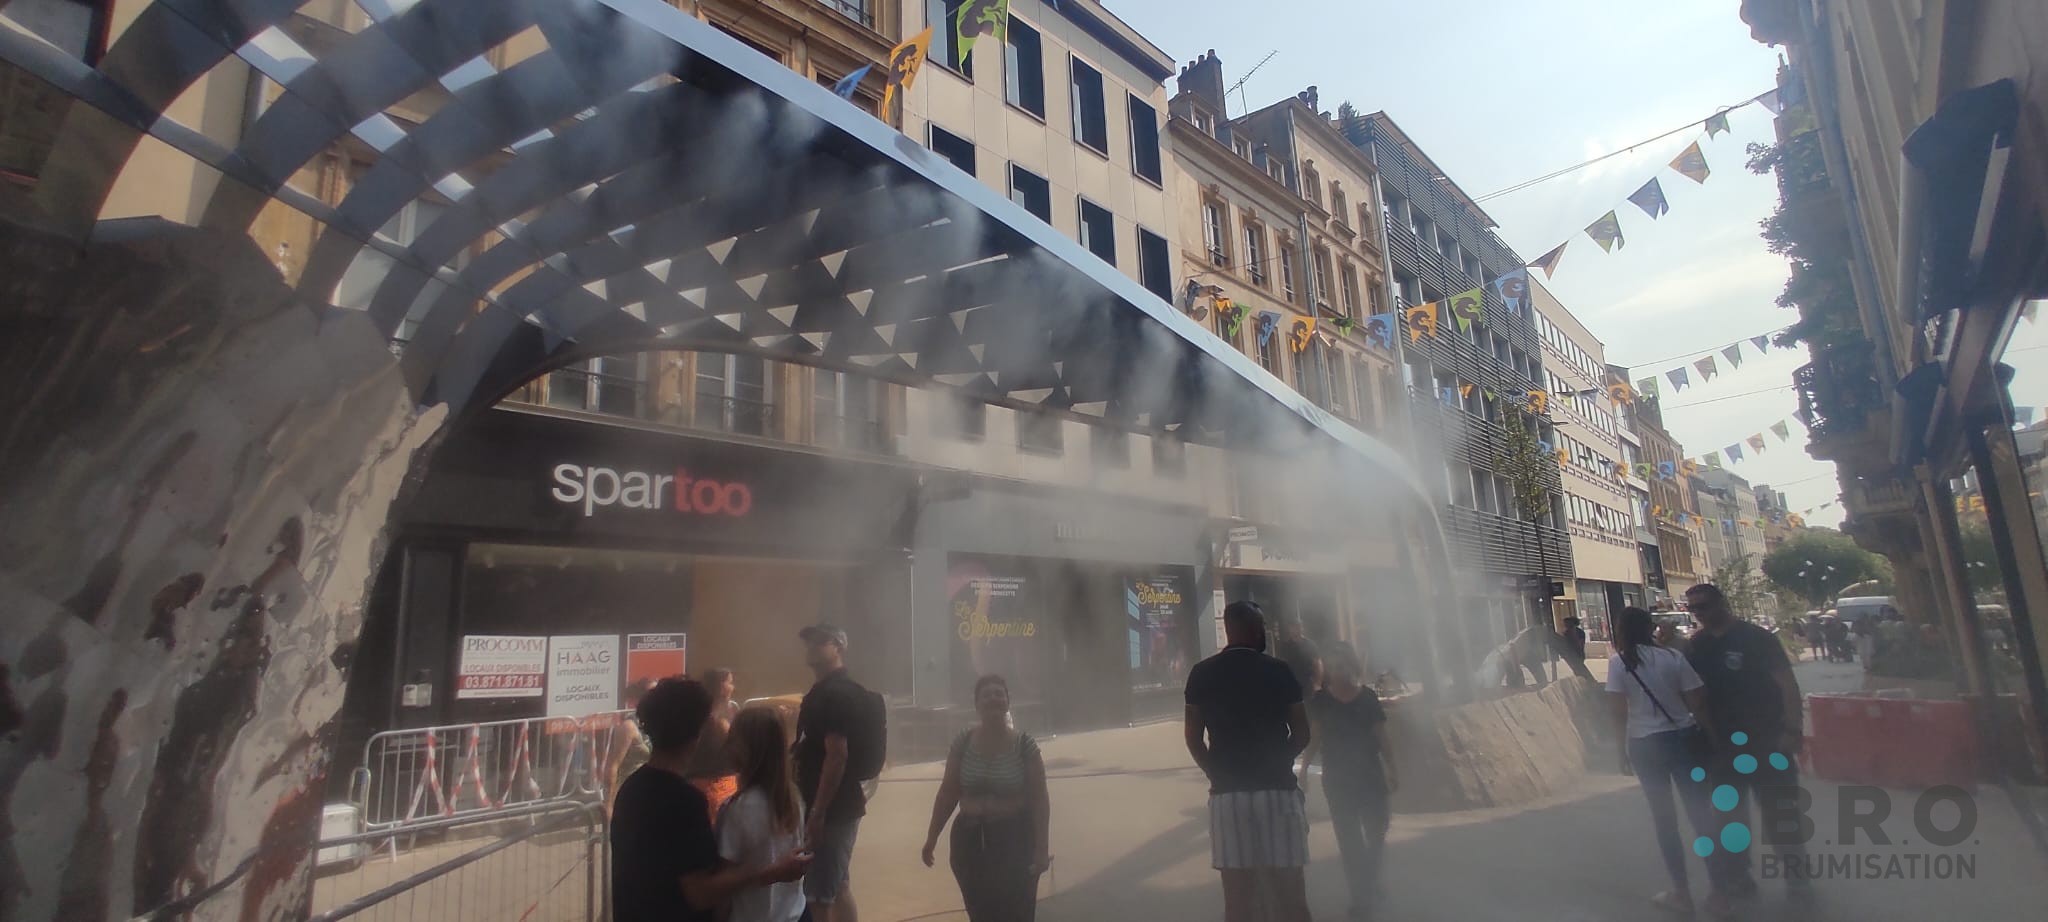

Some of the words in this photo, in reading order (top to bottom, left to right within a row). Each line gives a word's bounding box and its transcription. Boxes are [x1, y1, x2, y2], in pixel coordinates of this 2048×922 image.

[552, 463, 751, 517] spartoo
[465, 638, 545, 652] PROCOMM
[557, 650, 611, 665] HAAG
[464, 663, 494, 673] LOCAUX
[496, 663, 542, 673] DISPONIBLES
[556, 666, 610, 677] immobilier
[465, 675, 540, 689] 03.871.871.81
[566, 683, 601, 694] LOCAUX
[555, 692, 609, 703] DISPONIBLES
